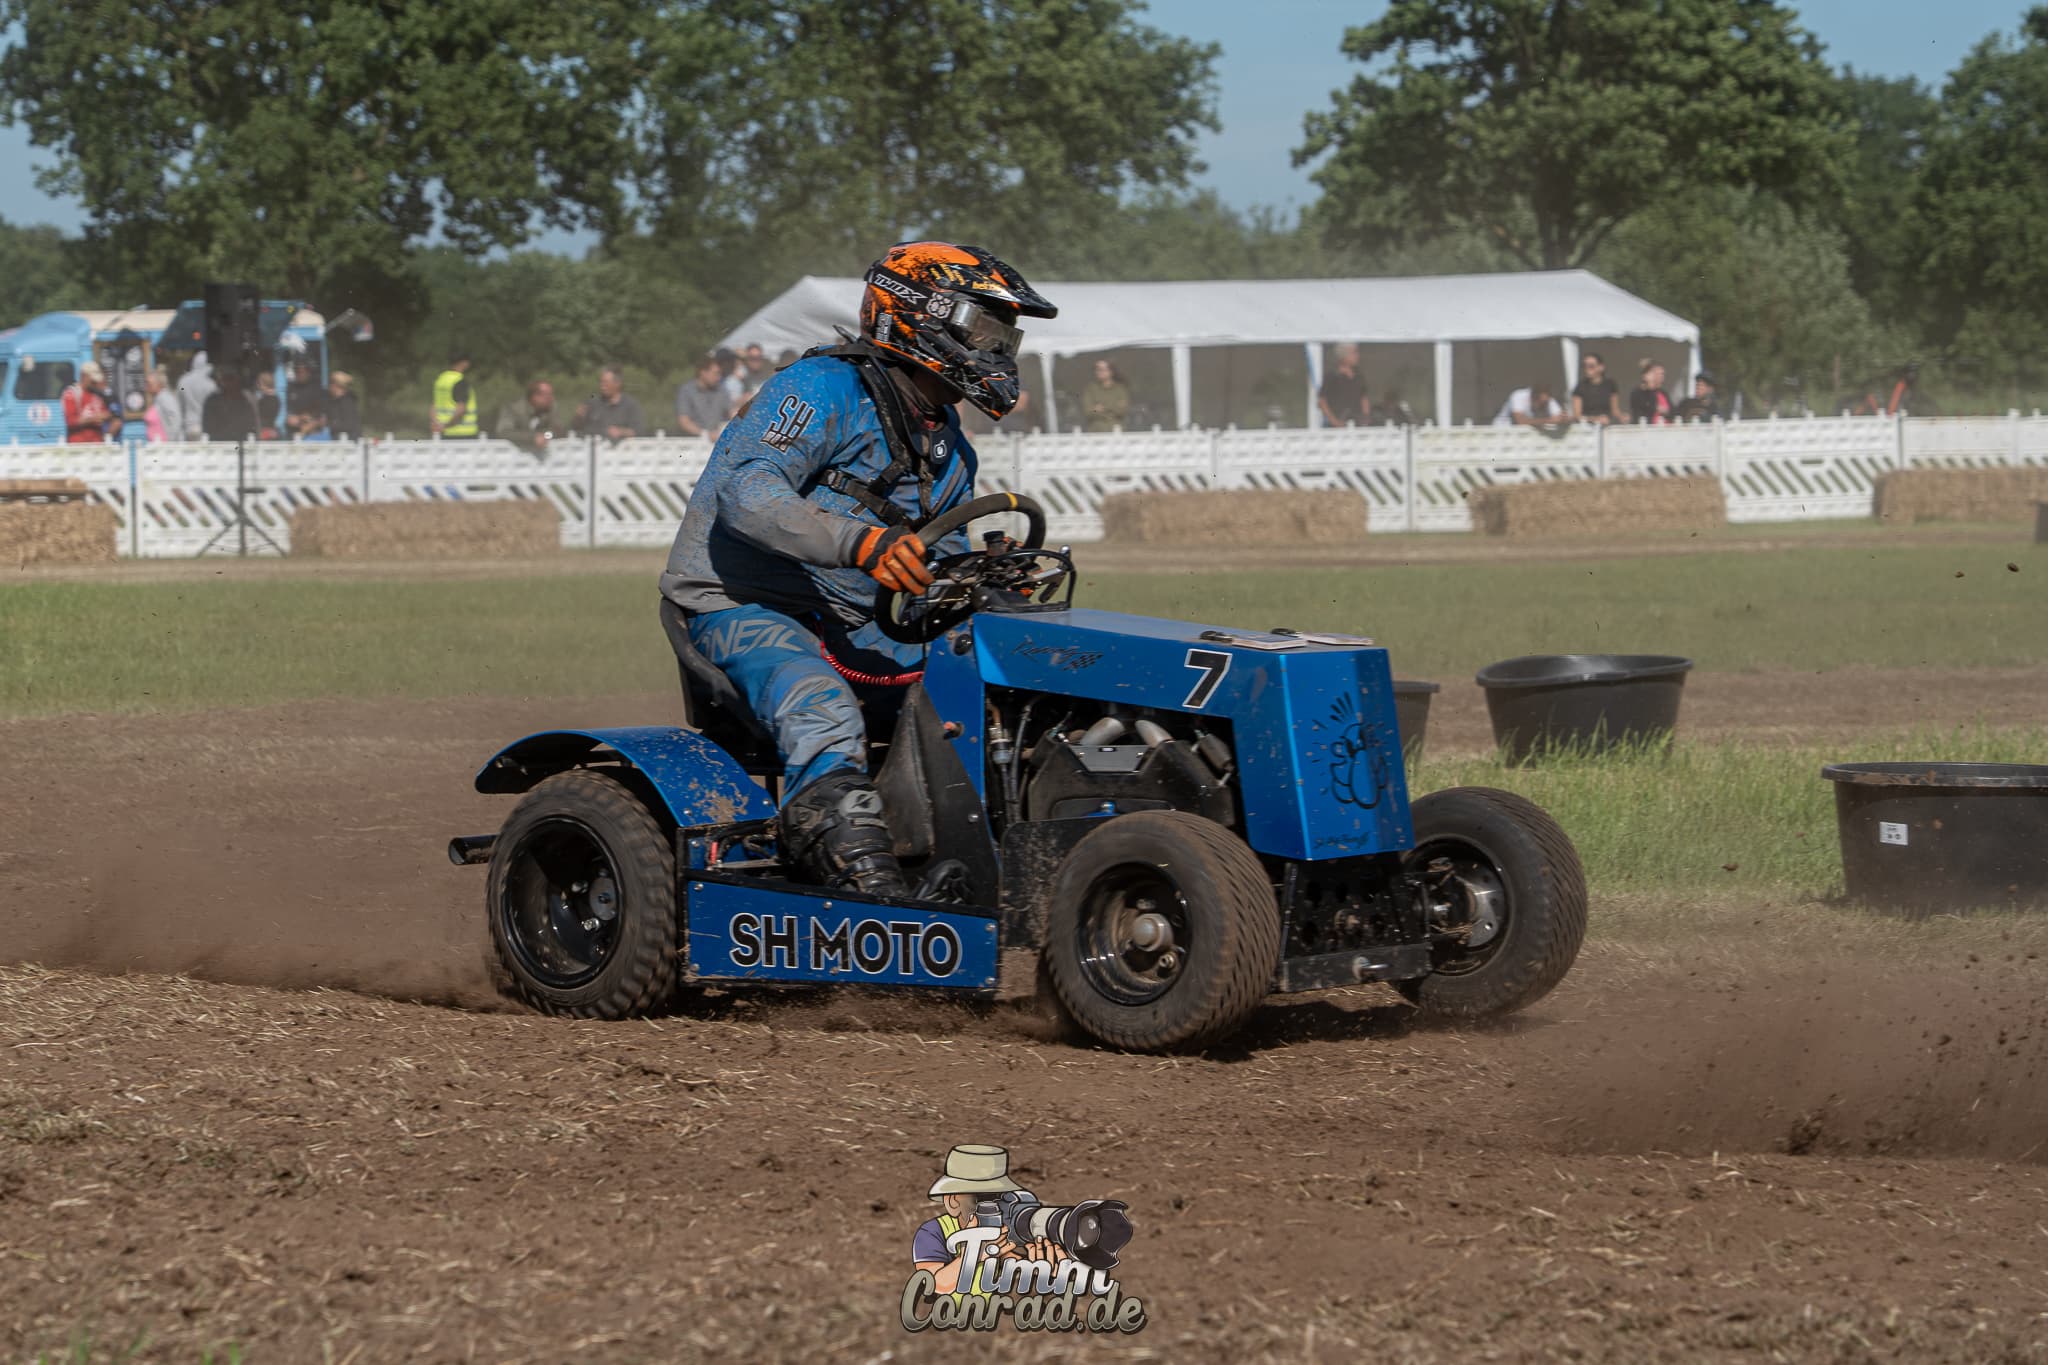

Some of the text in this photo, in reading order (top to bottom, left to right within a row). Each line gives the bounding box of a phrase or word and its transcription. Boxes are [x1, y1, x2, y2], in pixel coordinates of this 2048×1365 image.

[766, 393, 816, 440] SH
[1182, 648, 1233, 709] 7
[728, 912, 963, 978] SH MOTO
